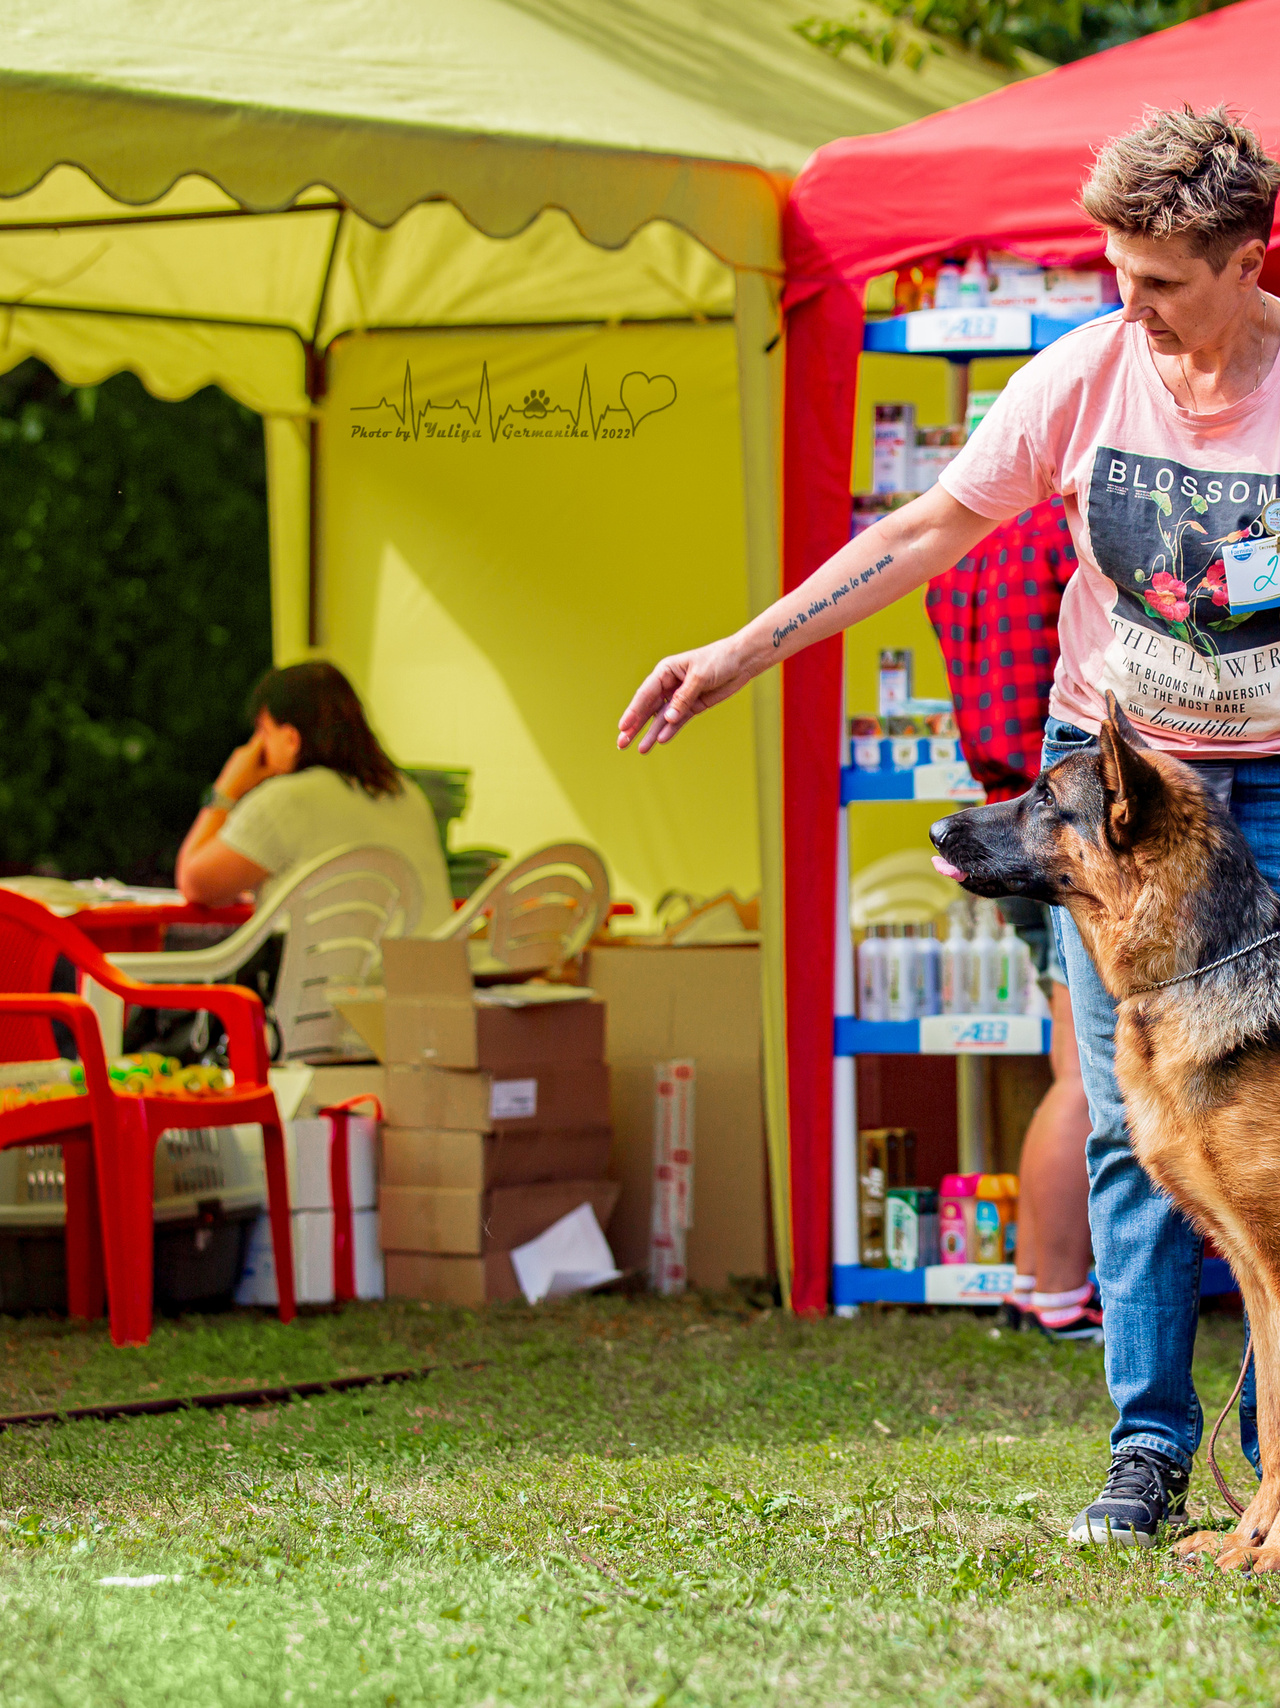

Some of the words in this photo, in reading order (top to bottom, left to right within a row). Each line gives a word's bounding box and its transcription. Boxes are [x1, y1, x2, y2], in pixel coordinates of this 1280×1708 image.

[1107, 459, 1277, 506] BLOSSOM
[849, 577, 860, 590] lo
[1111, 618, 1162, 659] THE
[1138, 681, 1148, 696] IS
[1153, 688, 1173, 704] THE
[1178, 697, 1210, 712] MOST
[1215, 703, 1246, 713] RARE
[1144, 668, 1189, 694] BLOOMS
[1193, 684, 1205, 698] IN
[1209, 682, 1272, 701] ADVERSITY
[1128, 704, 1144, 718] AND
[1150, 707, 1252, 739] beautiful.
